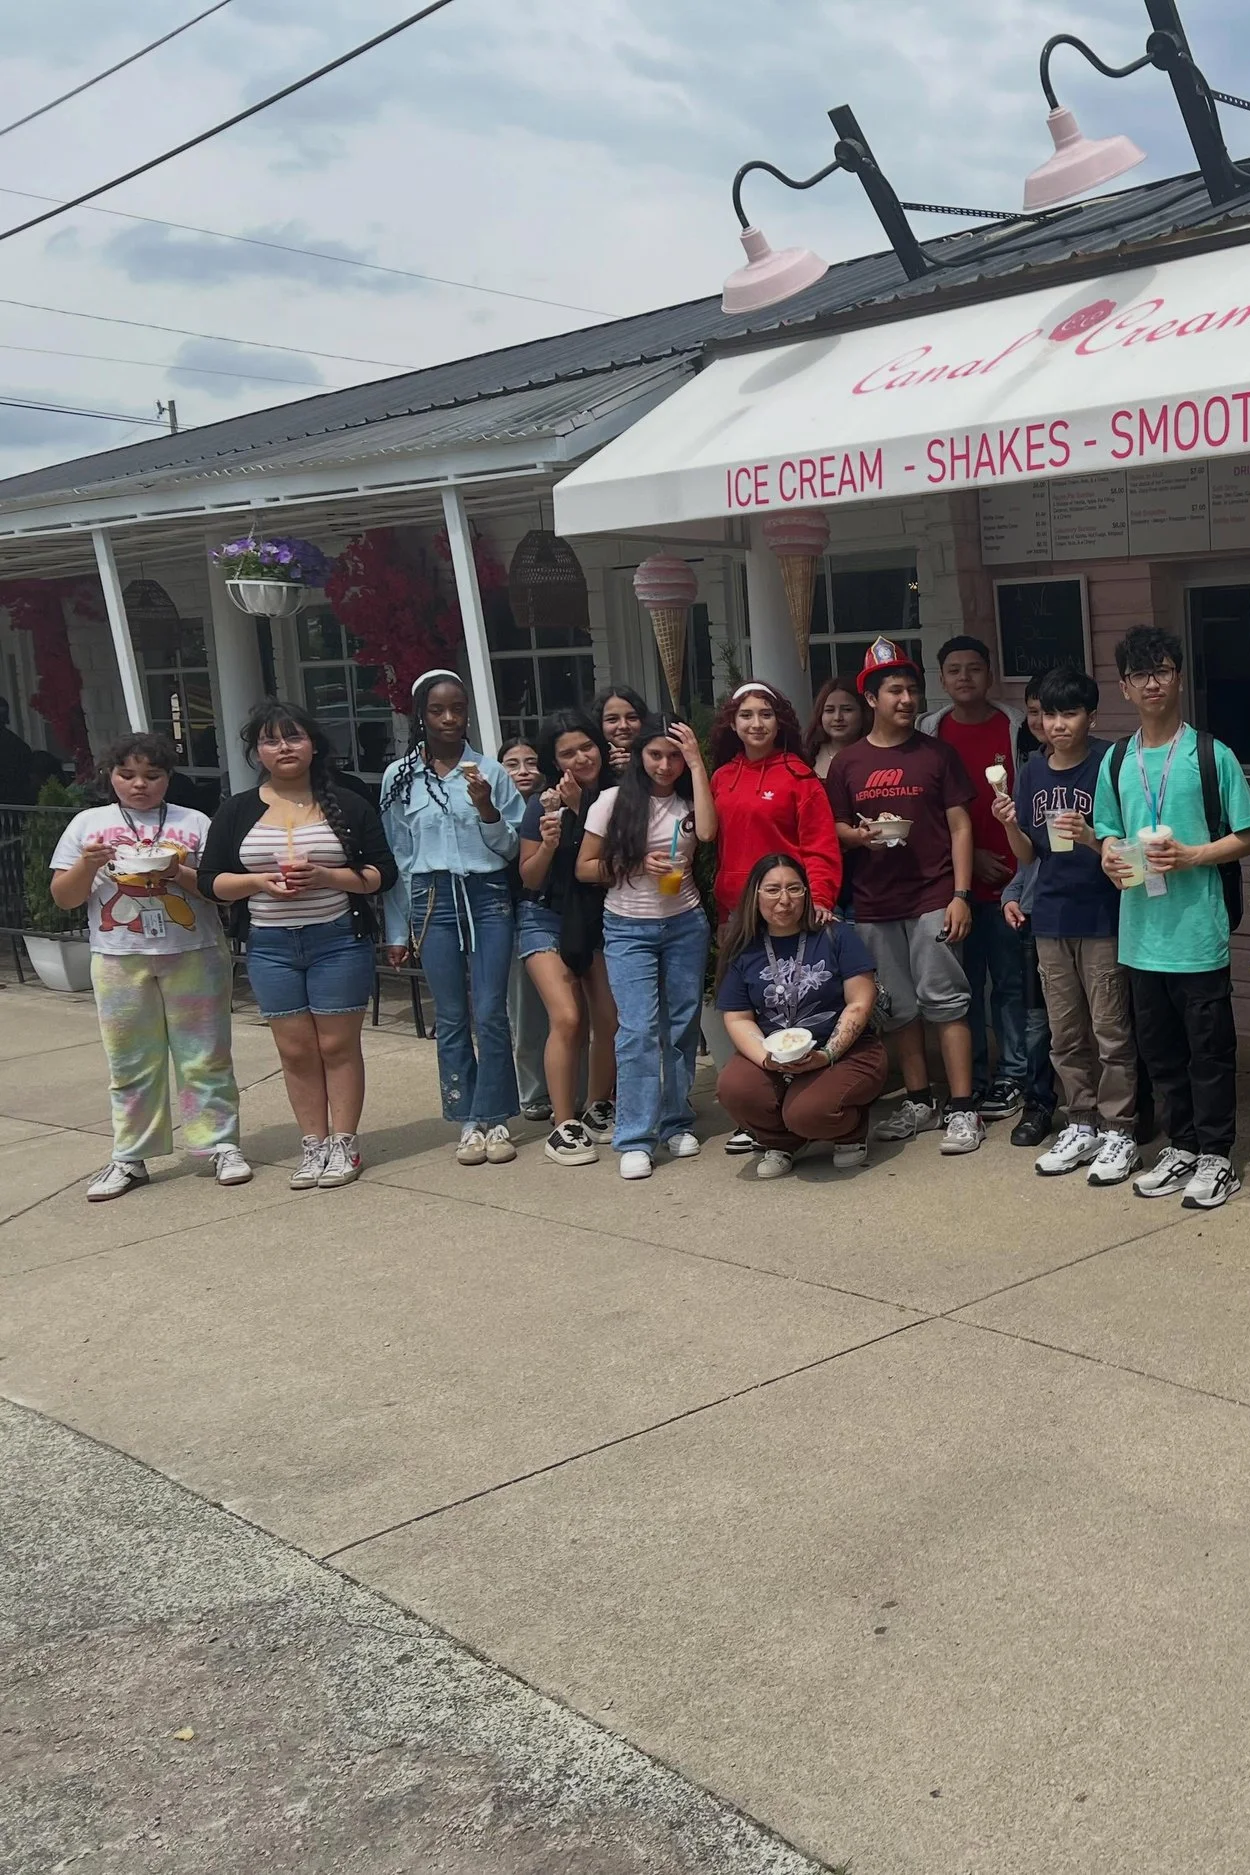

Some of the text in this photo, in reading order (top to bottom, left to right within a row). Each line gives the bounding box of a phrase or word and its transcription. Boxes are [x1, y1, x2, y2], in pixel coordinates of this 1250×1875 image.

[853, 329, 1041, 396] Canal
[727, 465, 769, 507] ICE
[779, 449, 883, 501] CREAM
[927, 420, 1072, 485] SHAKES
[1033, 787, 1092, 827] GAP
